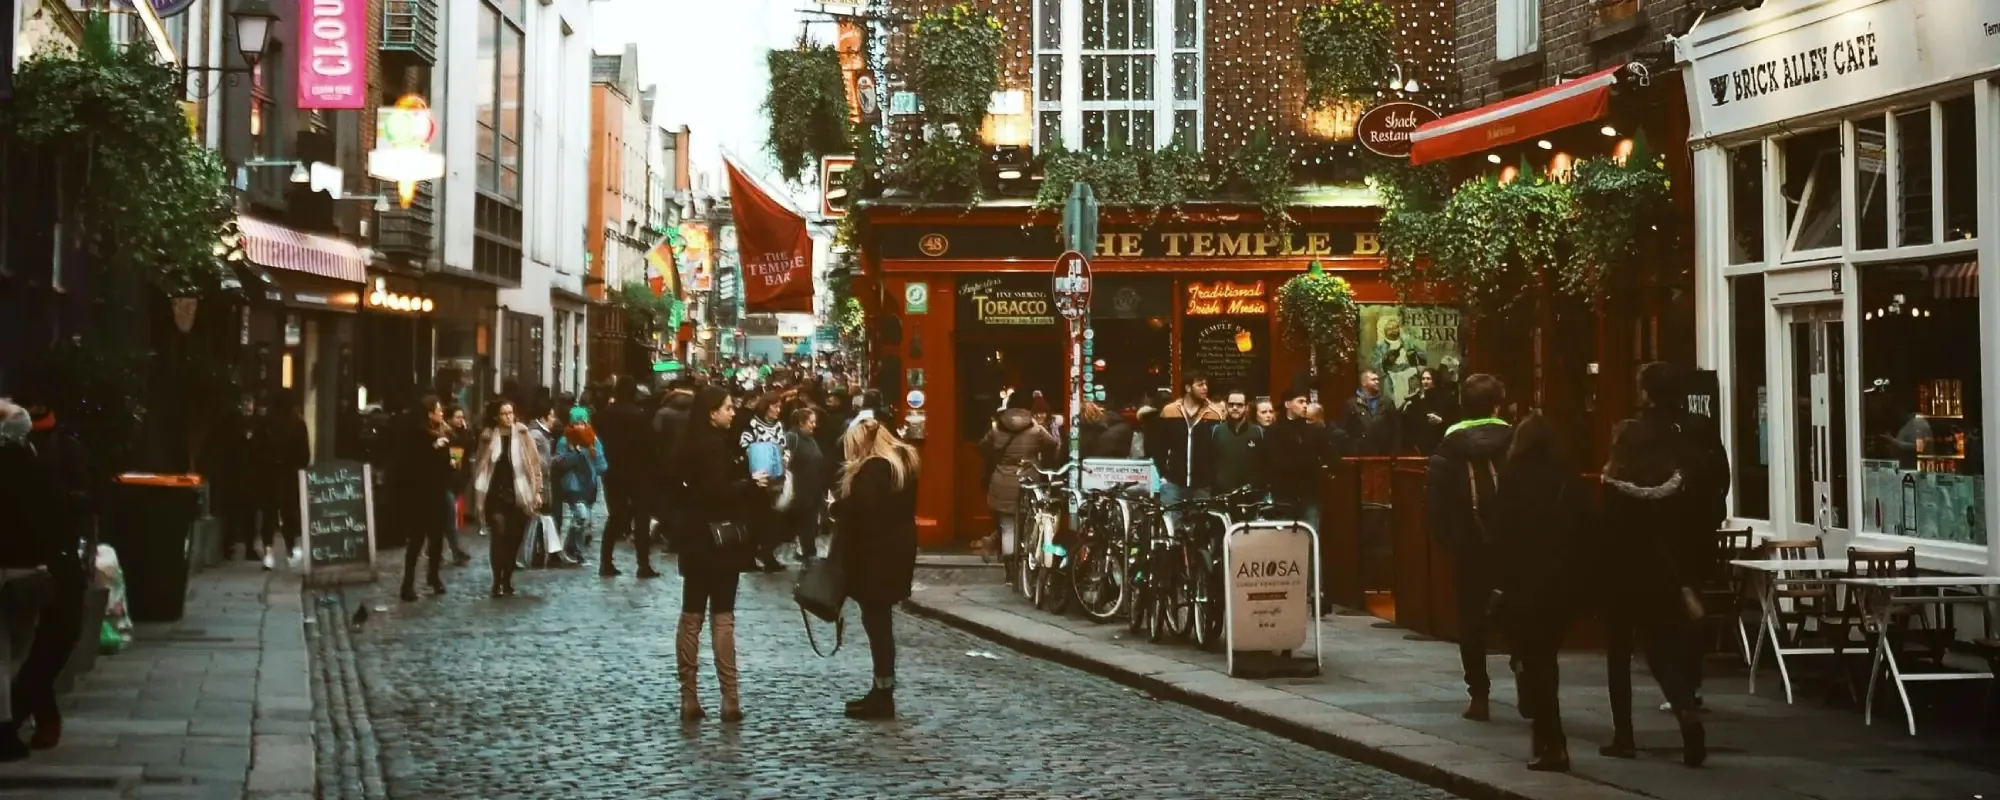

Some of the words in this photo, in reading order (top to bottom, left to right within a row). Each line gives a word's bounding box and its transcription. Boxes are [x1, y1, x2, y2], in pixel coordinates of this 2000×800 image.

[1732, 60, 1779, 101] BRICK
[1782, 46, 1828, 89] ALLEY
[1833, 21, 1879, 75] CAFÉ
[1385, 111, 1417, 129] Shack
[1370, 130, 1413, 142] Restau
[924, 237, 942, 251] 48
[1094, 233, 1143, 257] HE
[1160, 233, 1332, 257] TEMPLE
[764, 252, 789, 262] THE
[747, 256, 805, 276] TEMPLE
[764, 272, 791, 286] BAR
[1188, 283, 1263, 299] Traditional
[972, 295, 1047, 321] TOBACCO
[1186, 300, 1220, 315] Irish
[1227, 300, 1265, 315] Music
[1421, 328, 1458, 342] BAR
[1236, 560, 1300, 579] ARIOSA
